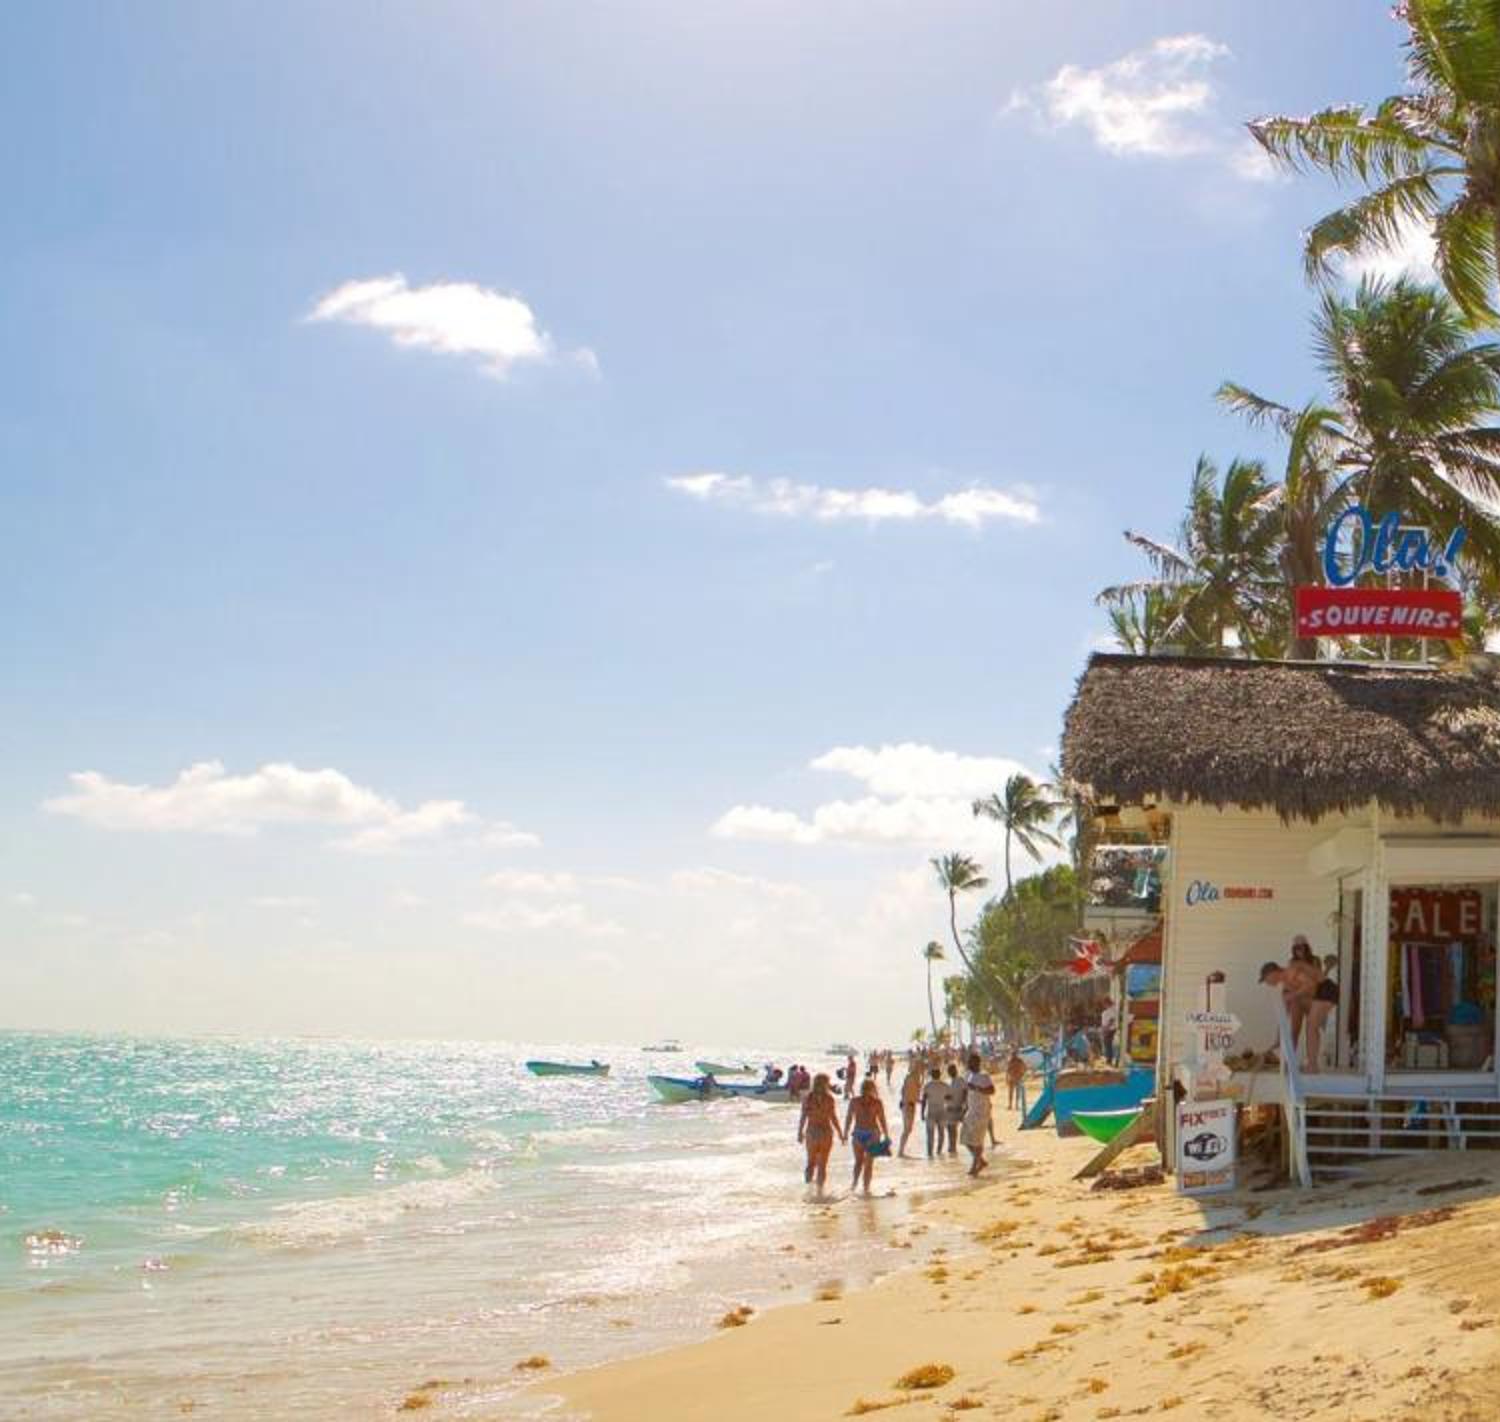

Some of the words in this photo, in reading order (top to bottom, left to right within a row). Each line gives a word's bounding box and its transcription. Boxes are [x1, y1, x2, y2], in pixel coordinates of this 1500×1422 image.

[1324, 504, 1468, 587] Ola!
[1309, 604, 1452, 629] SOUVENIRS
[1185, 879, 1219, 907] Ola
